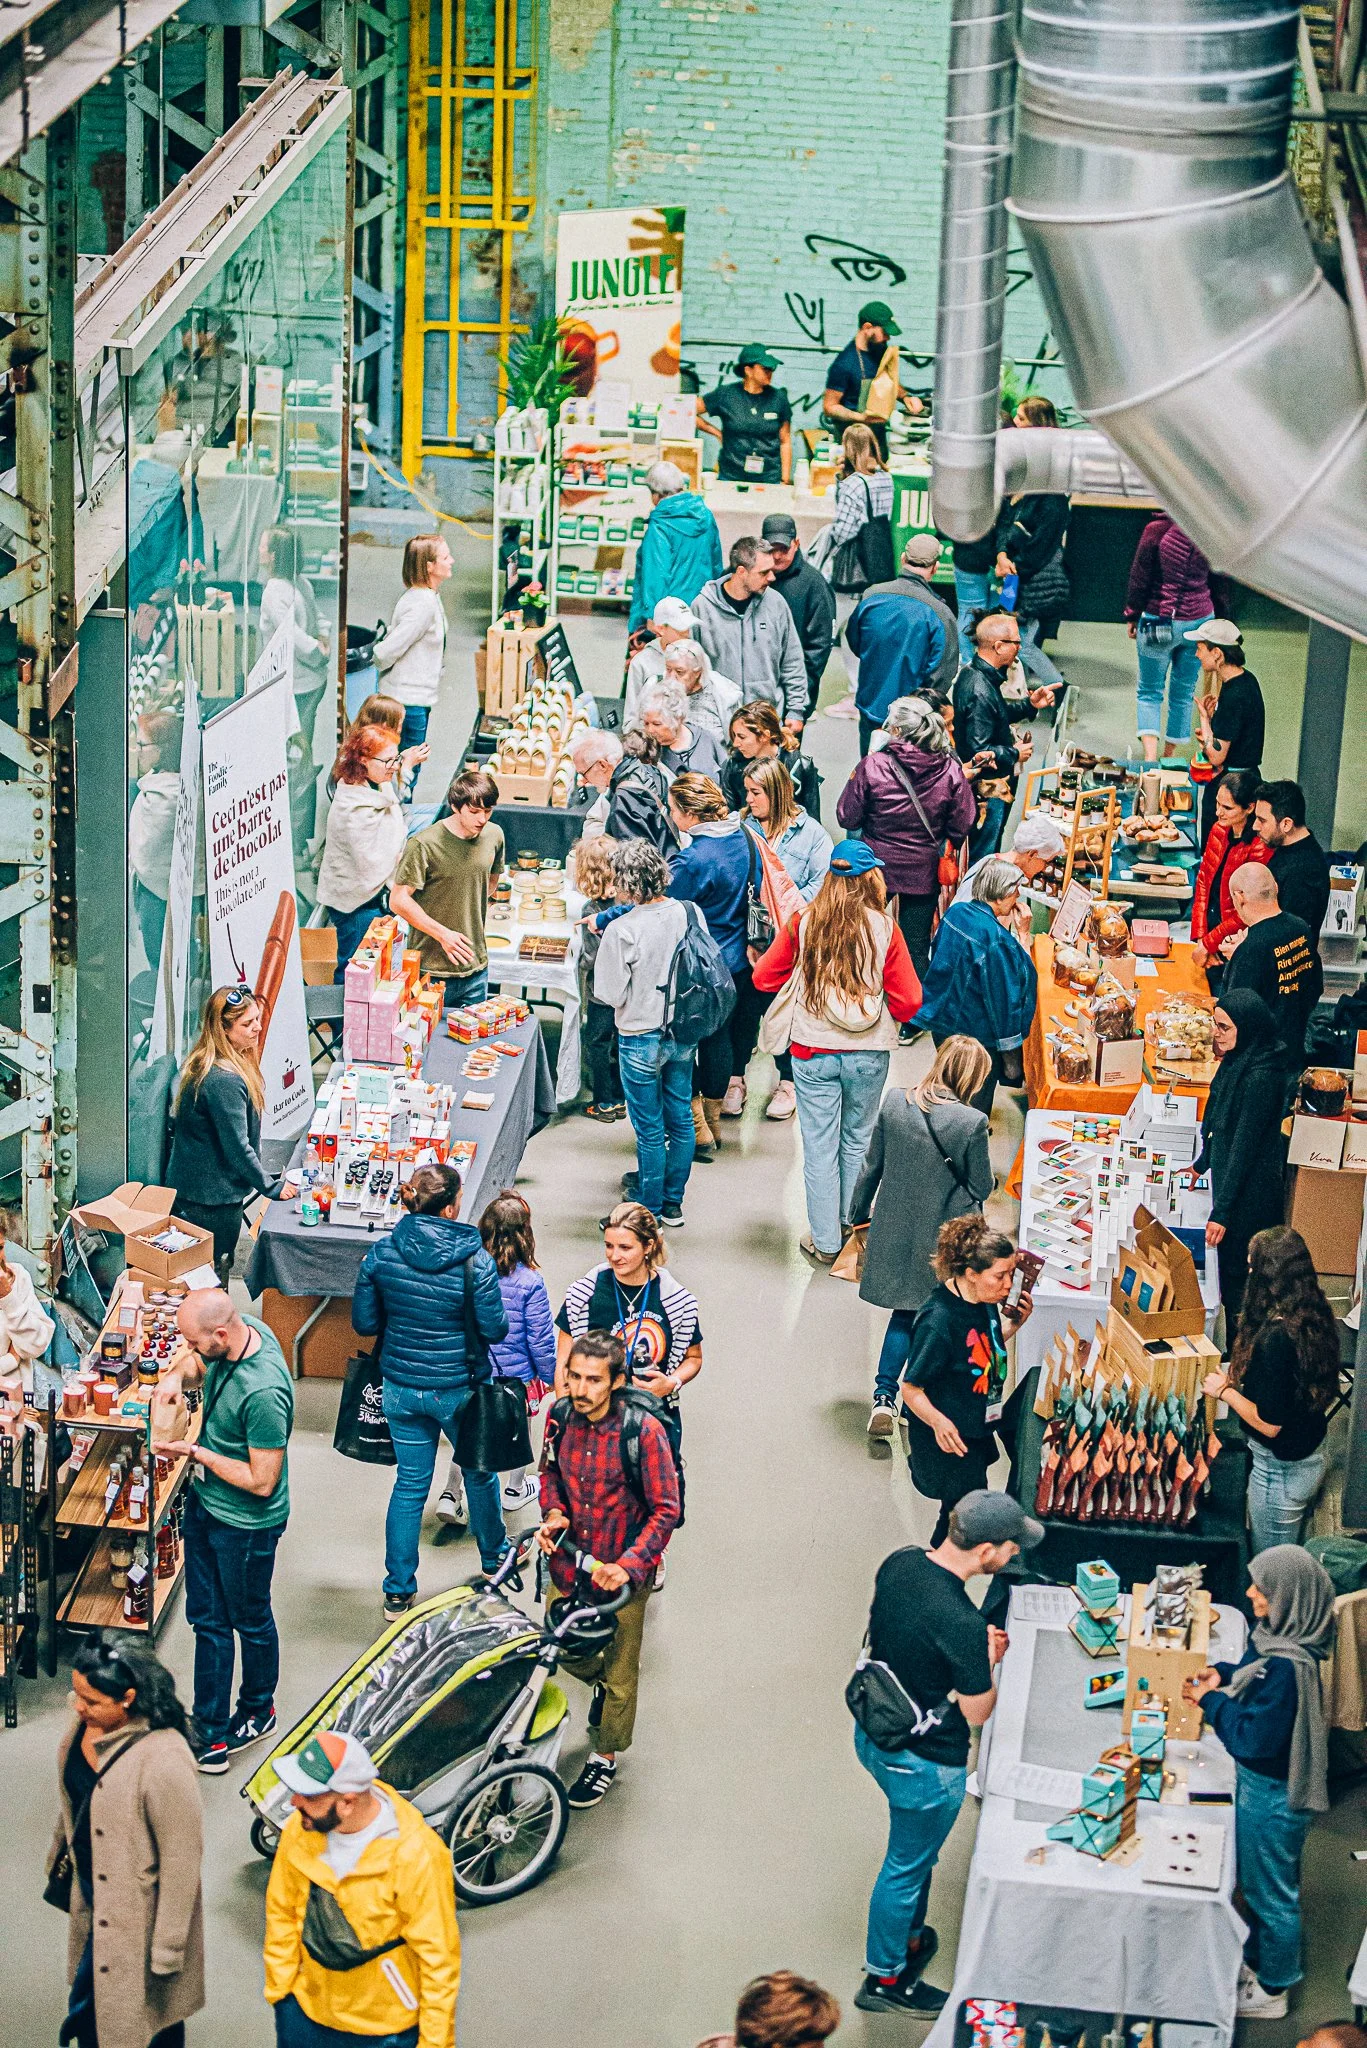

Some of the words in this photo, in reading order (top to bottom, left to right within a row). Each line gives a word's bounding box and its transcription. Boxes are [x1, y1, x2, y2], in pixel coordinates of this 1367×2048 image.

[568, 254, 676, 302] JUNGLE
[208, 761, 218, 774] The
[208, 766, 228, 785] Foodie
[208, 777, 228, 796] Family
[212, 798, 236, 834] Ceci
[238, 782, 267, 817] n'est
[269, 769, 287, 802] pas
[213, 829, 236, 858] une
[237, 805, 272, 840] barre
[214, 856, 230, 881] de
[231, 819, 282, 868] chocolat
[215, 883, 232, 904] This
[231, 878, 238, 893] is
[239, 868, 254, 887] not
[215, 886, 253, 921] chocolate
[254, 877, 267, 895] bar
[1274, 944, 1290, 958] Bien
[1277, 958, 1292, 970] Rire
[273, 1102, 284, 1114] Bar
[284, 1098, 291, 1106] to
[291, 1085, 306, 1101] Cook
[273, 1098, 308, 1126] www.bartocook.com
